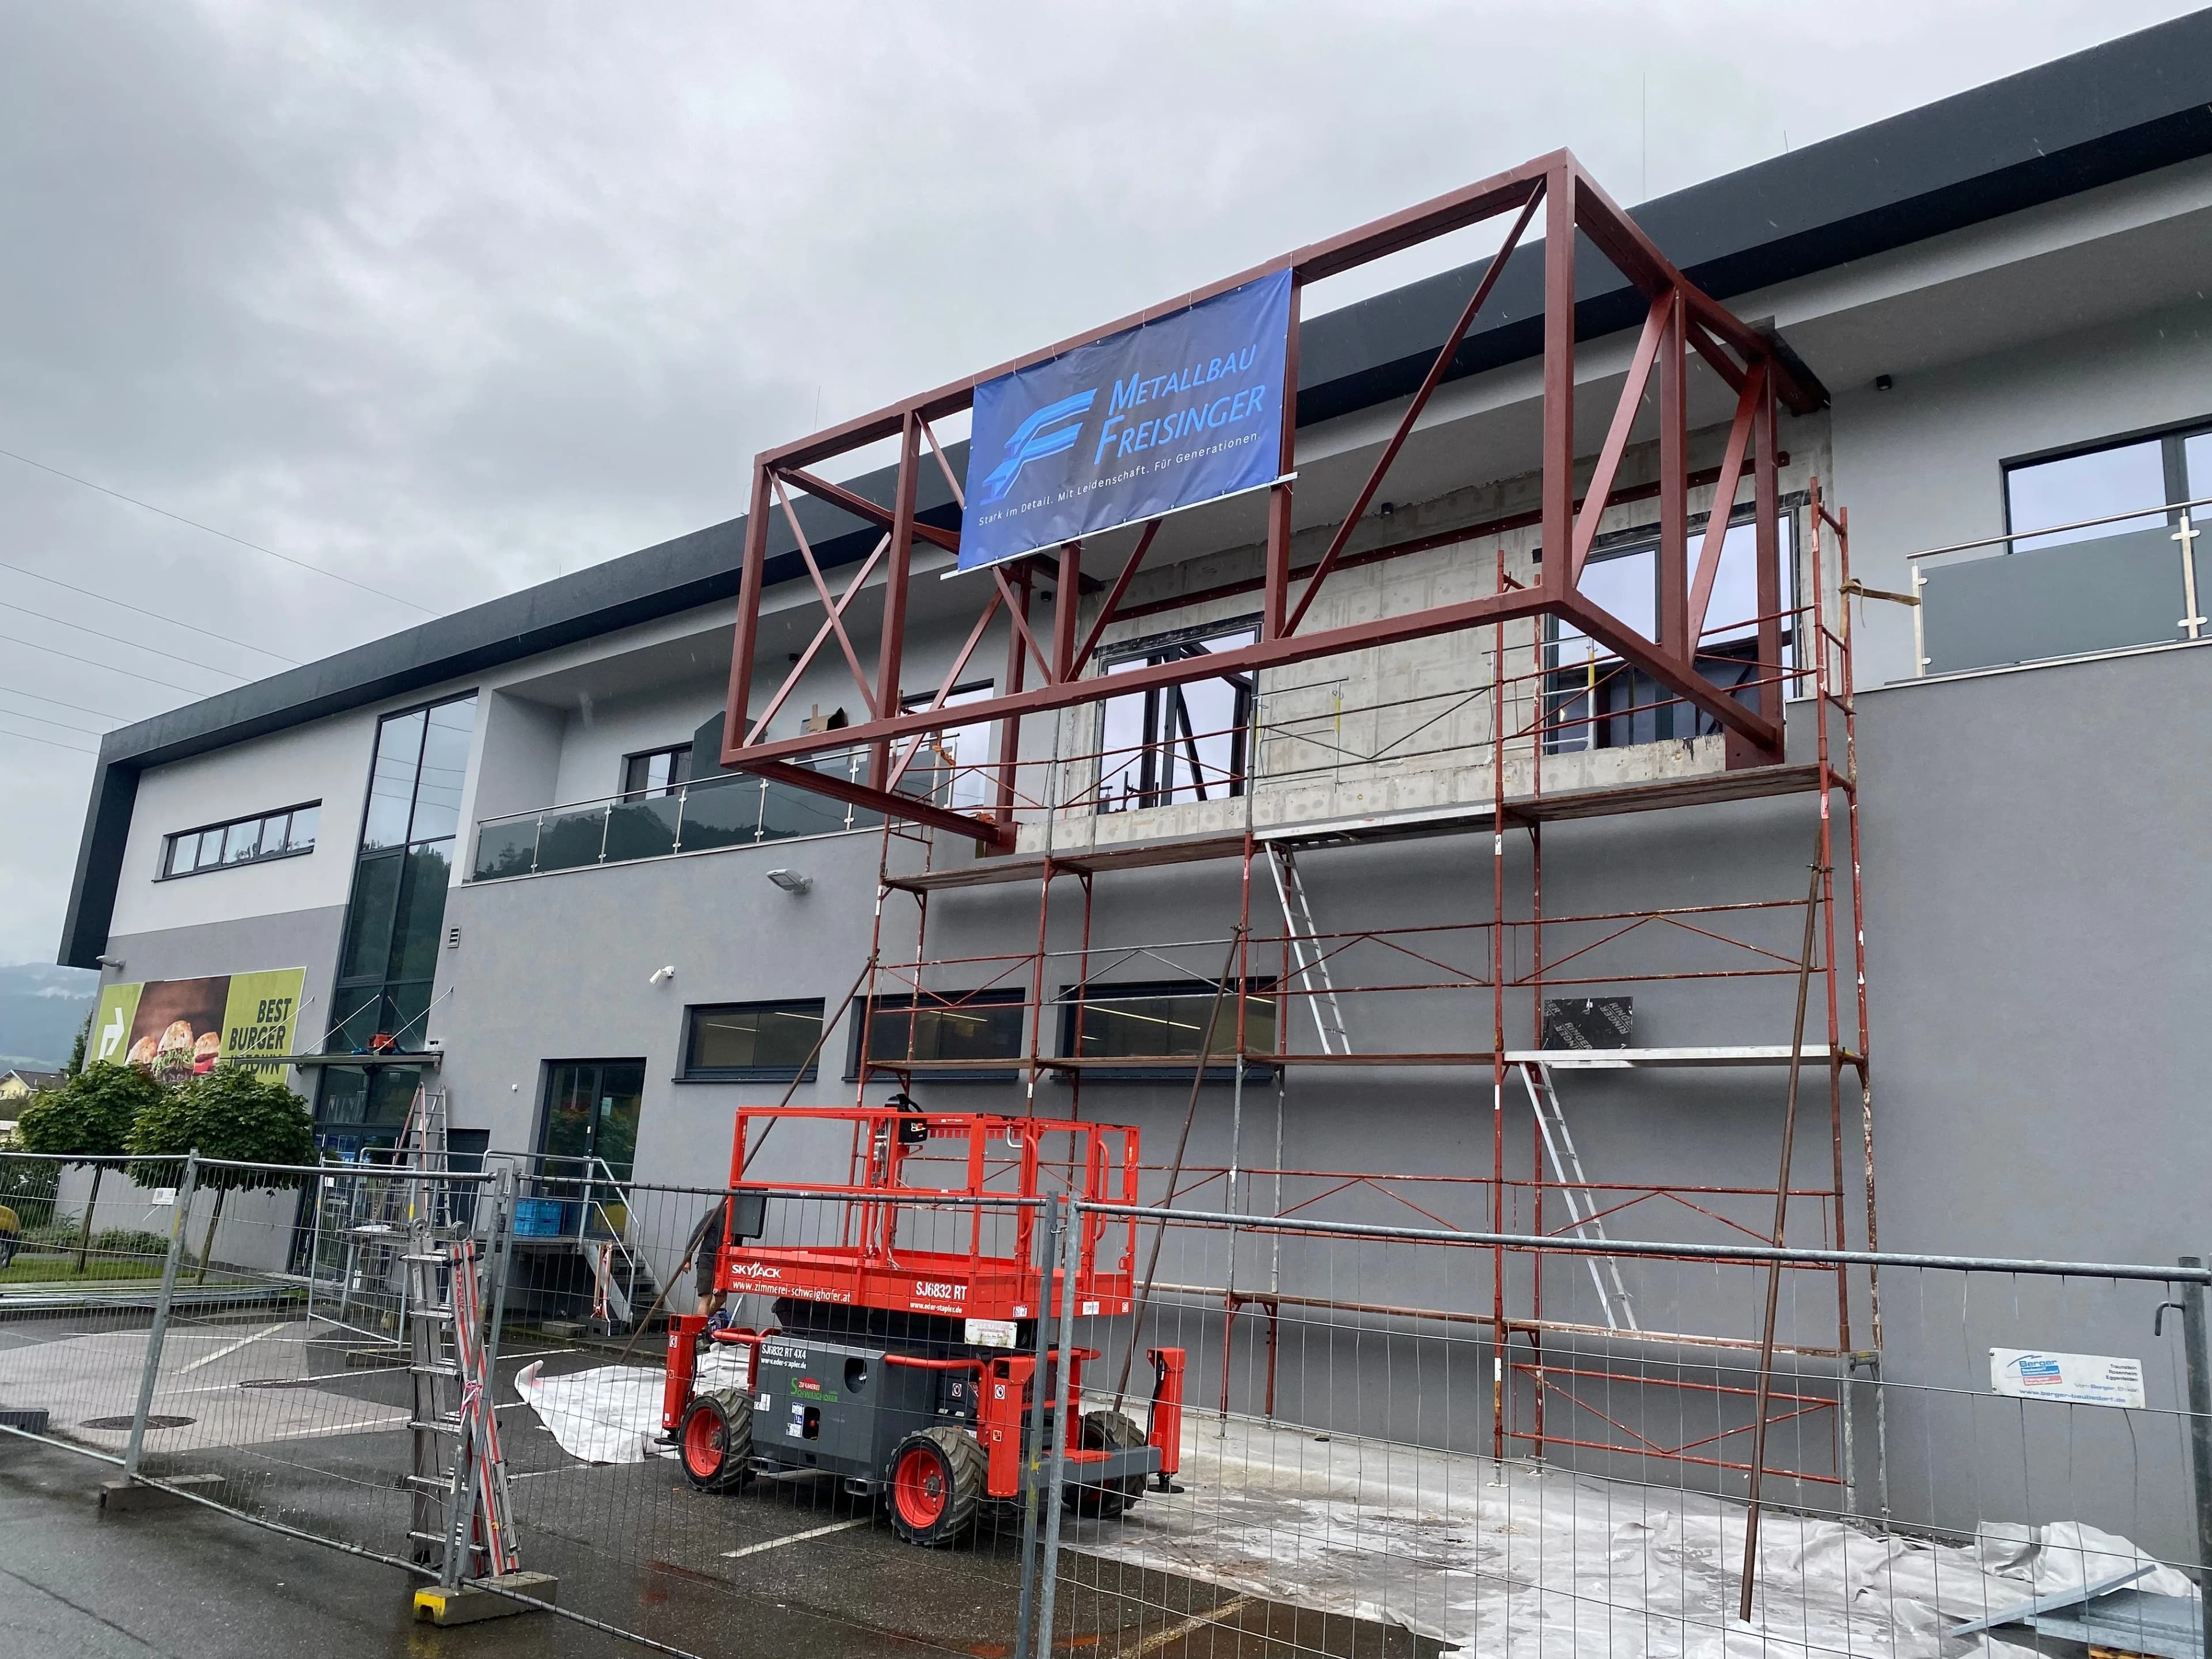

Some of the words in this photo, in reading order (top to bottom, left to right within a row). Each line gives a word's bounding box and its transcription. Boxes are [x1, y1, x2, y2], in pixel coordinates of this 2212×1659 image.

[1108, 343, 1257, 416] METALLBAU
[1094, 385, 1266, 465] FREISINGER
[979, 511, 1002, 526] Stark
[1006, 506, 1017, 517] im
[1021, 496, 1053, 513] Detail.
[1058, 487, 1073, 503] Mit
[1077, 465, 1149, 495] Leidenschaft.
[1154, 459, 1172, 473] Für
[1176, 431, 1262, 464] Generationen.
[257, 998, 292, 1023] BEST
[229, 1026, 286, 1051] BURGER
[732, 1262, 781, 1278] SKYJACK
[732, 1281, 851, 1302] www.zimmerei-schwaighofer.at
[916, 1281, 951, 1299] SJ6832
[954, 1285, 967, 1300] RT
[762, 1344, 783, 1357] SJ6832
[785, 1347, 793, 1358] RT
[794, 1349, 806, 1359] 4X4
